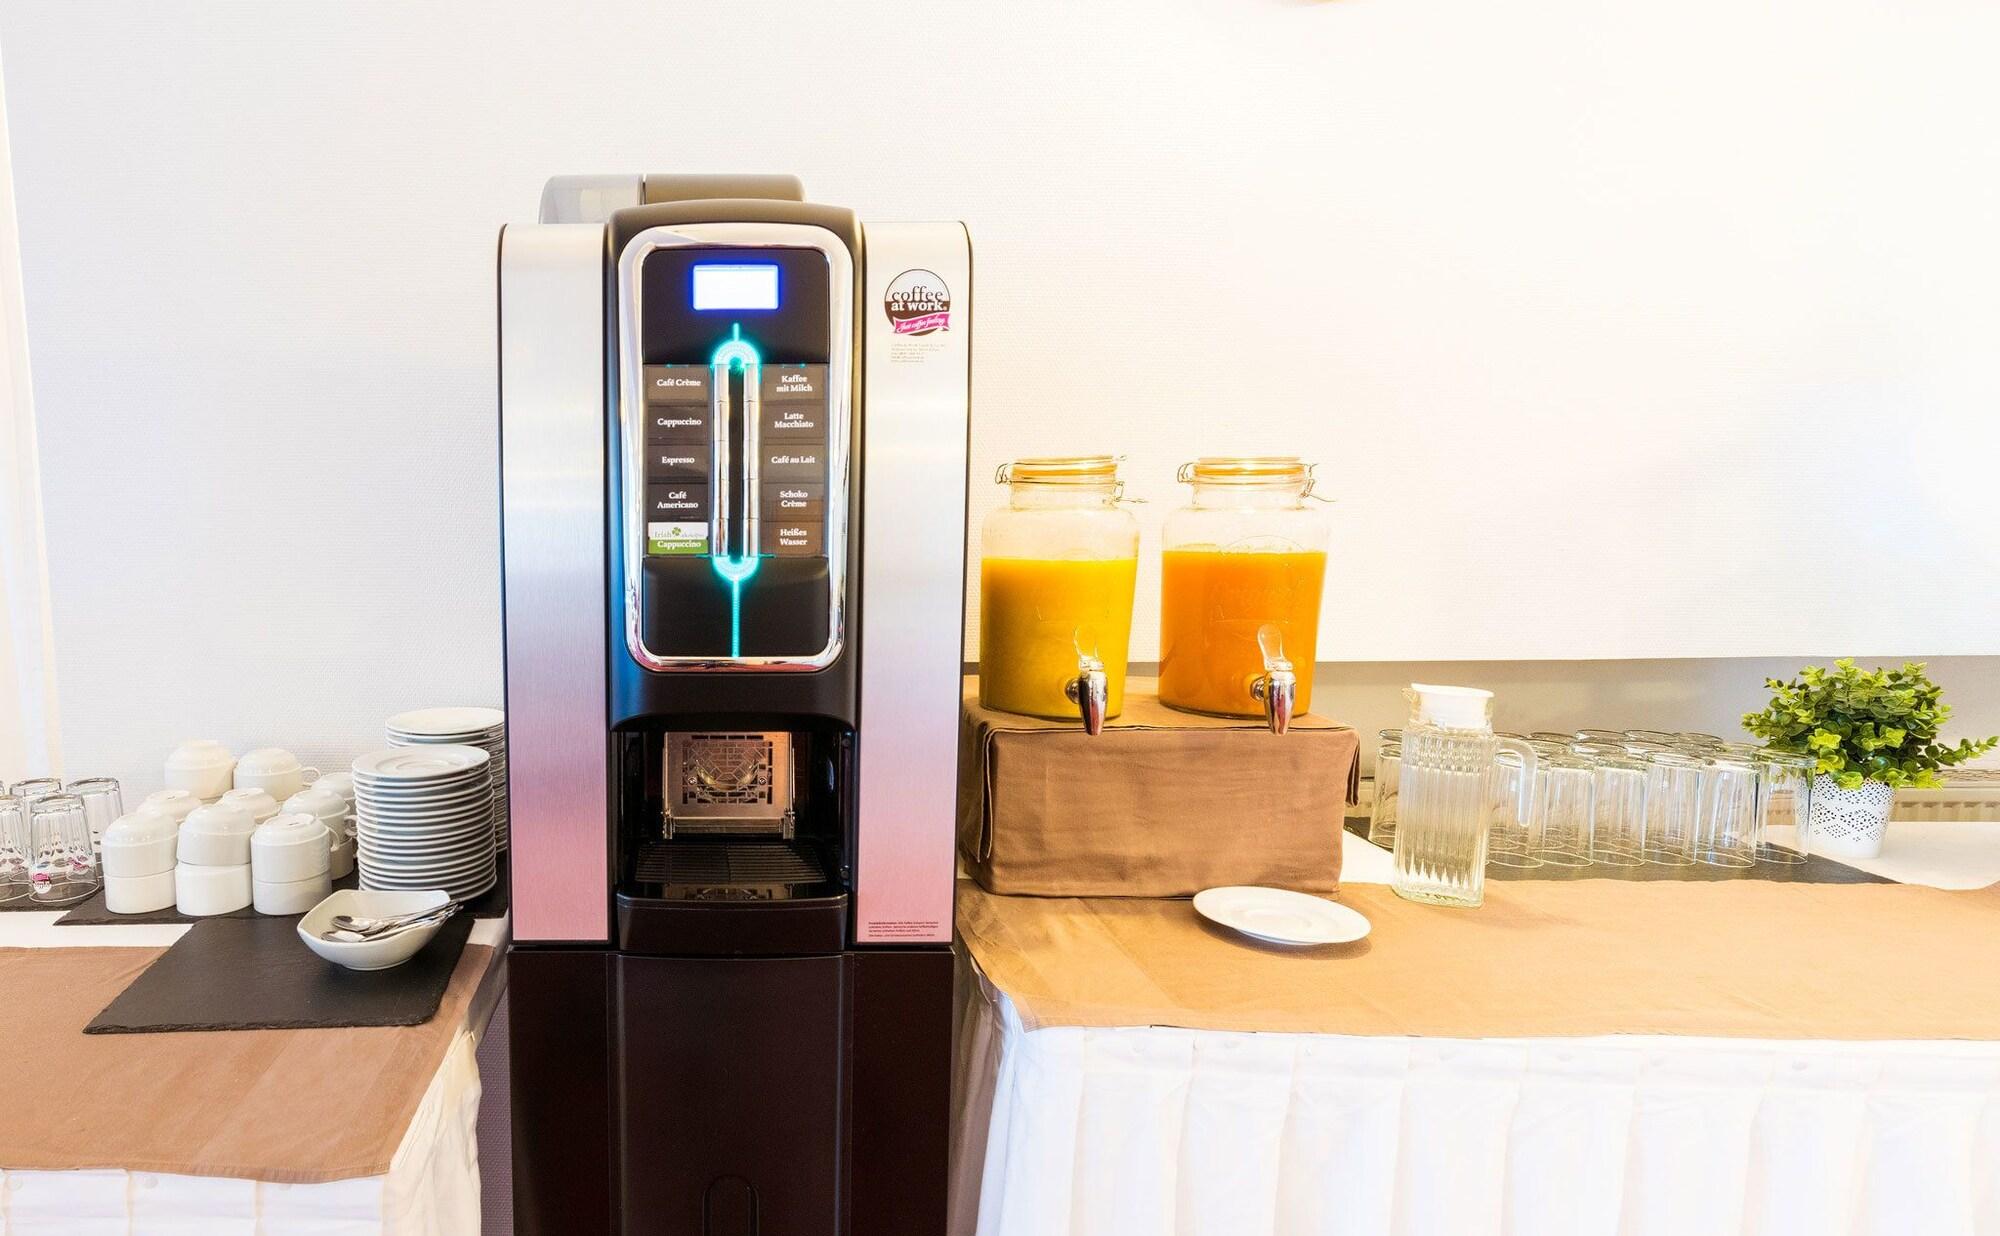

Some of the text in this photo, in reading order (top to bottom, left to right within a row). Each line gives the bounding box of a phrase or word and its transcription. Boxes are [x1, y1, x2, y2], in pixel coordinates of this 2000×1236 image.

[892, 286, 943, 302] coffee
[891, 300, 948, 311] at work.
[656, 378, 702, 387] Café Crème
[781, 375, 808, 383] Kaffee
[776, 383, 813, 392] mit Milch
[784, 412, 804, 420] Latte
[657, 417, 702, 427] Cappuccino
[774, 420, 814, 429] Macchiato
[661, 456, 696, 466] Espresso
[771, 455, 790, 464] Café
[800, 455, 816, 464] Lait
[668, 491, 687, 500] Café
[780, 489, 808, 498] Schoko
[657, 500, 699, 509] Americano
[781, 499, 807, 507] Crème
[780, 528, 807, 537] Heißes
[657, 540, 701, 549] Cappuccino
[780, 538, 808, 546] Wasser
